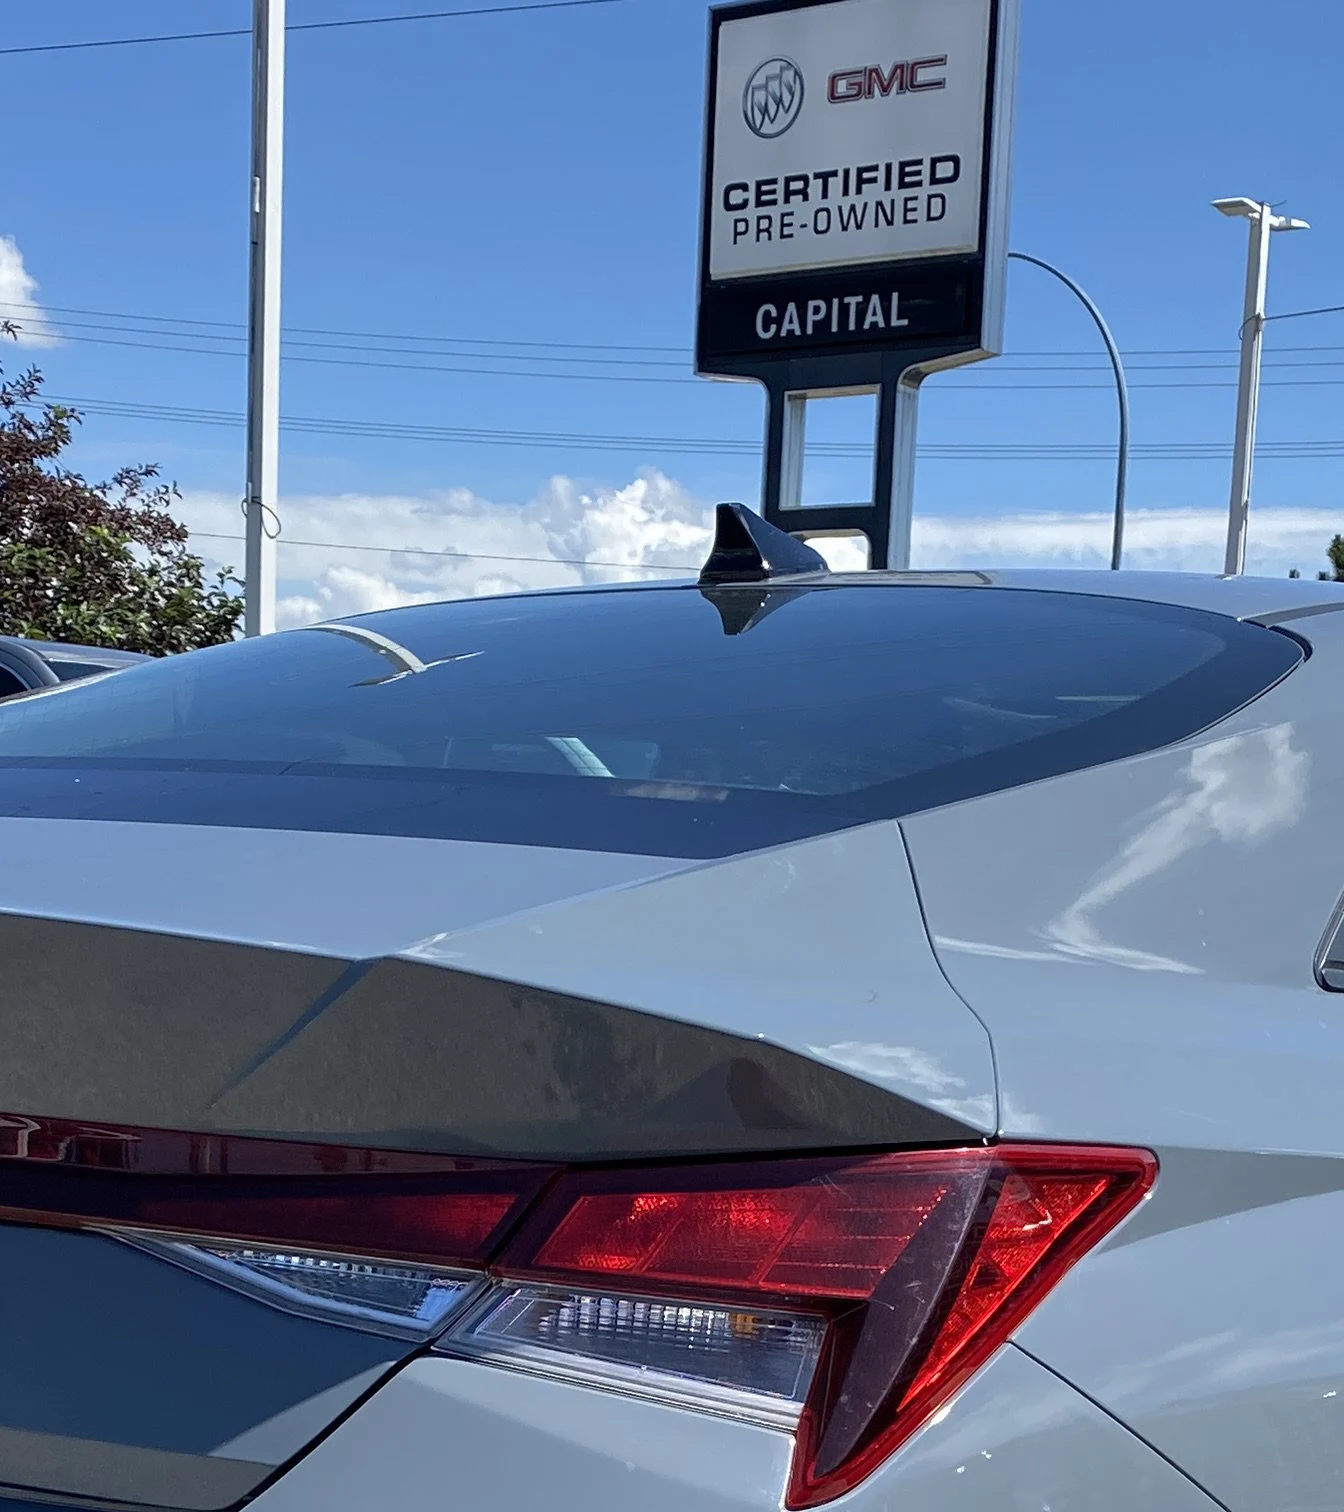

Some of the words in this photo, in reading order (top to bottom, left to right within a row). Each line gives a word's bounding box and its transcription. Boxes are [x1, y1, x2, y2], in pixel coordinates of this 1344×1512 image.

[827, 54, 948, 104] GMC
[723, 154, 961, 212] CERTIFIED
[733, 192, 947, 244] PRE-OWNED
[756, 291, 909, 340] CAPITAL
